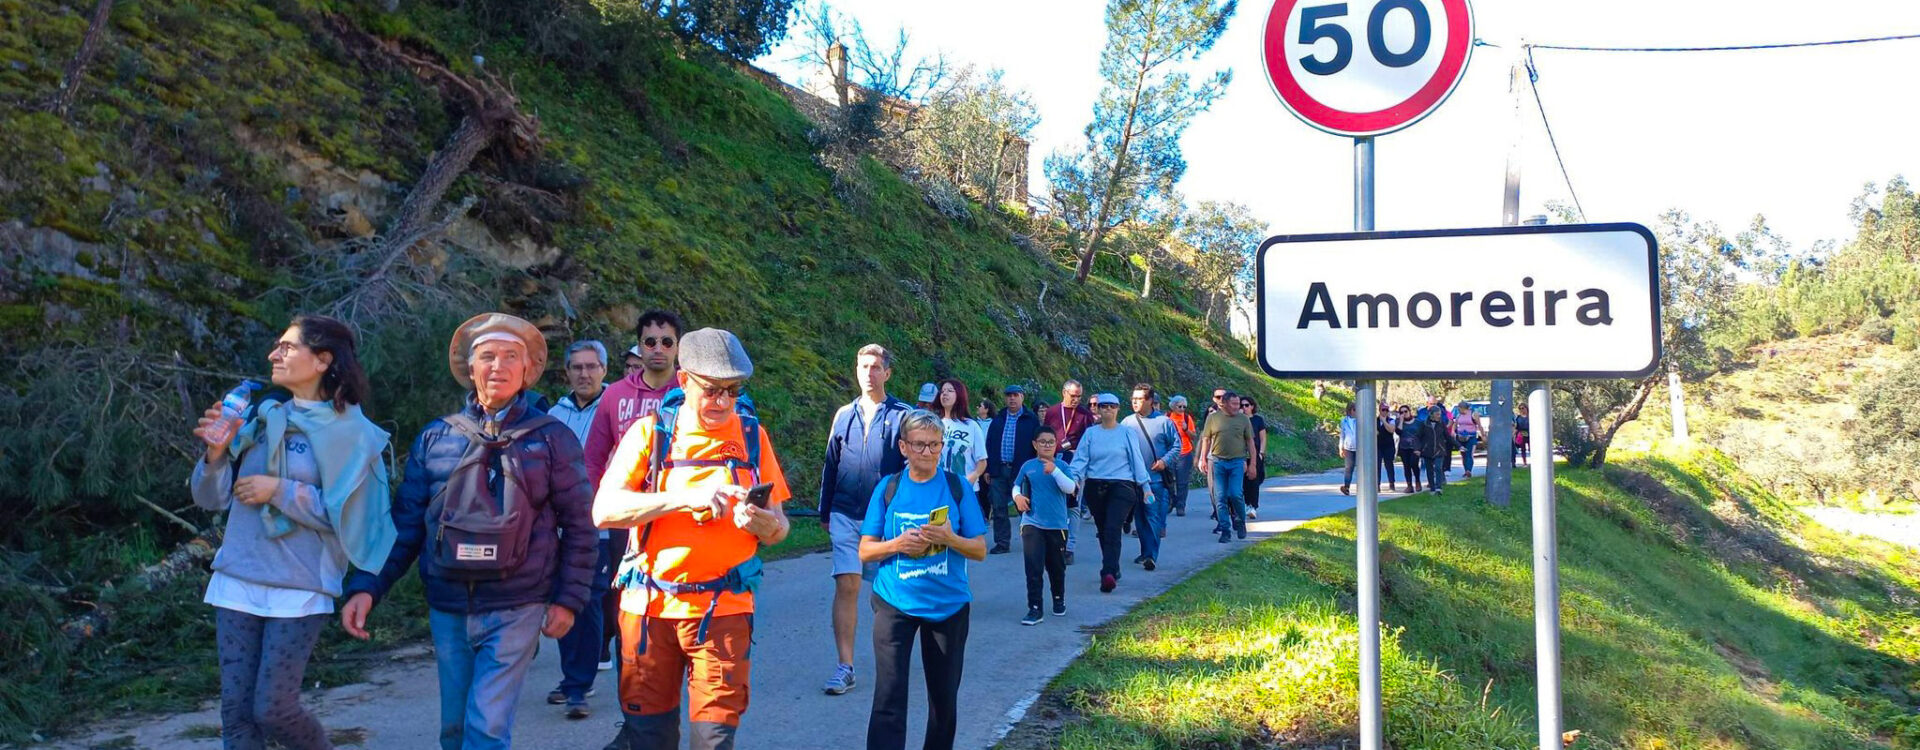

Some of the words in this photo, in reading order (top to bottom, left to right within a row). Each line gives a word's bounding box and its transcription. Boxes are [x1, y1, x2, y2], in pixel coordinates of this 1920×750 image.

[1298, 0, 1432, 76] 50
[1296, 276, 1614, 330] Amoreira
[618, 398, 664, 422] CAIFO
